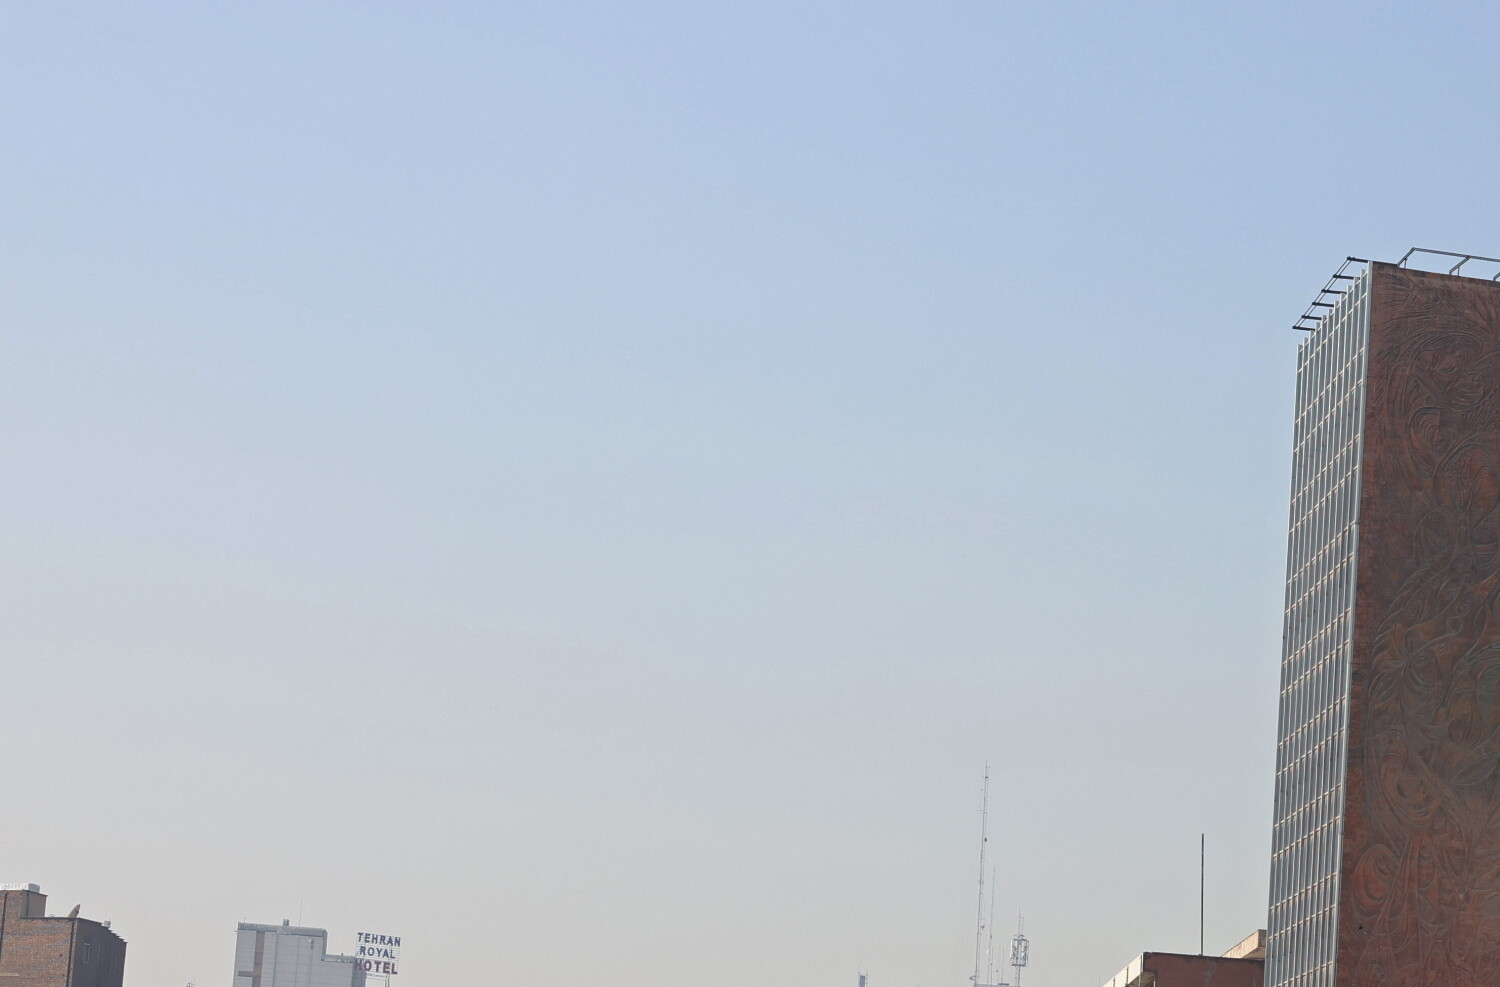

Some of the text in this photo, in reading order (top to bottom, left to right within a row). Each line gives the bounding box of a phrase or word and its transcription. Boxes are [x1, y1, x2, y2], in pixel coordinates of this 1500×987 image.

[357, 932, 401, 947] TEHRAN
[360, 946, 396, 959] ROYAL
[355, 958, 398, 975] HOTEL
